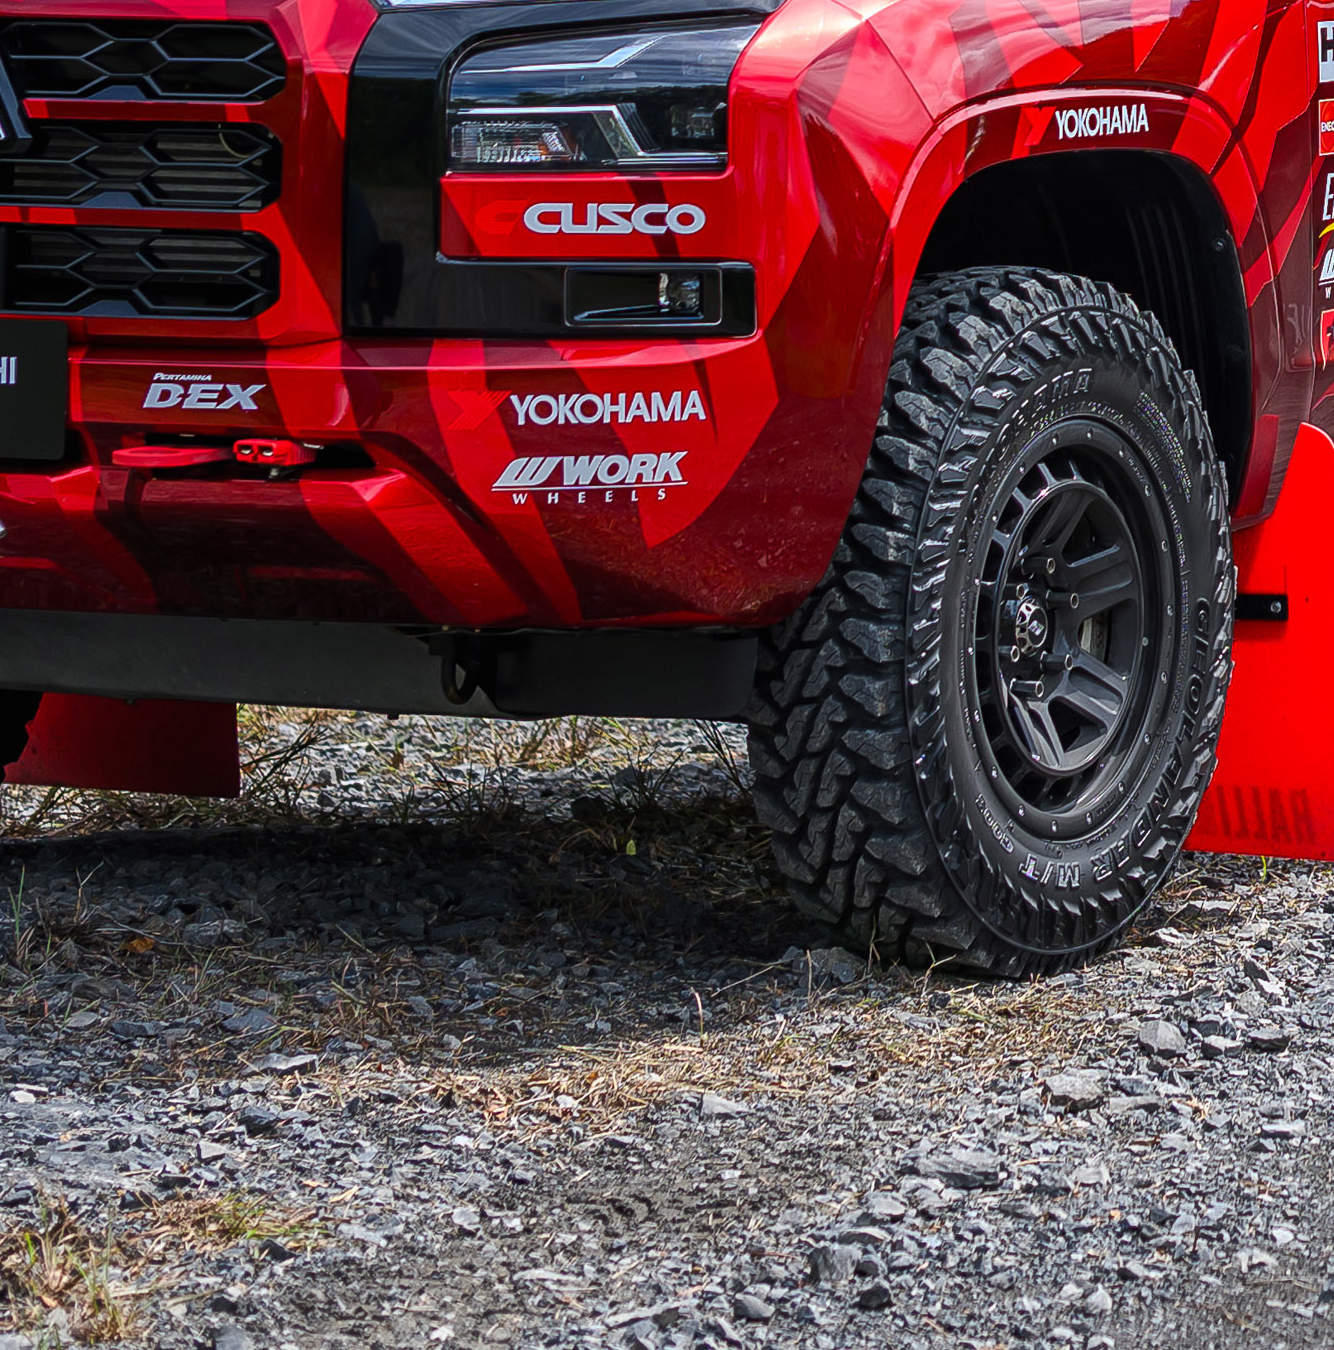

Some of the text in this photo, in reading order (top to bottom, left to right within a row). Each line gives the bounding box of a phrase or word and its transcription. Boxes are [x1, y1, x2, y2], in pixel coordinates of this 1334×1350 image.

[1055, 103, 1149, 140] YOKOHAMA
[523, 202, 706, 235] CUSCO
[142, 383, 267, 410] DEX
[511, 389, 707, 426] YOKOHAMA
[512, 488, 666, 505] WHEELS
[1019, 853, 1081, 888] M/T
